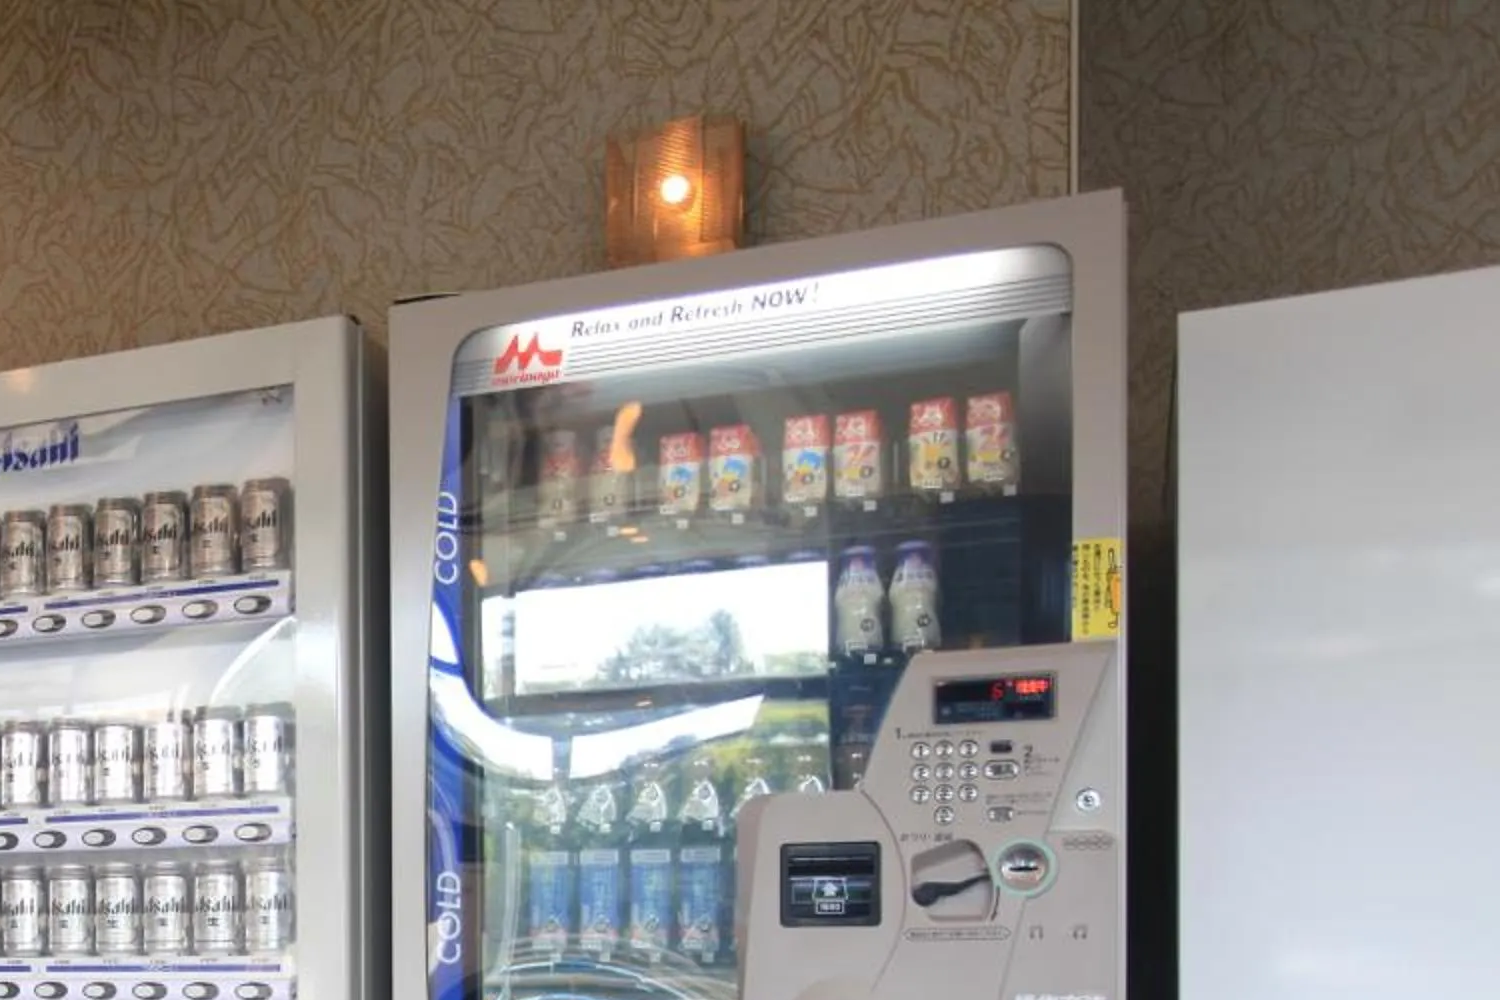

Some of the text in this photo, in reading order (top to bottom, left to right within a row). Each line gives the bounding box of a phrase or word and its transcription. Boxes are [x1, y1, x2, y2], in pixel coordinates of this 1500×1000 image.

[571, 320, 620, 338] Relax
[629, 312, 663, 332] and
[670, 299, 743, 323] Refresh
[434, 491, 459, 585] COLD
[435, 869, 462, 964] COLD
